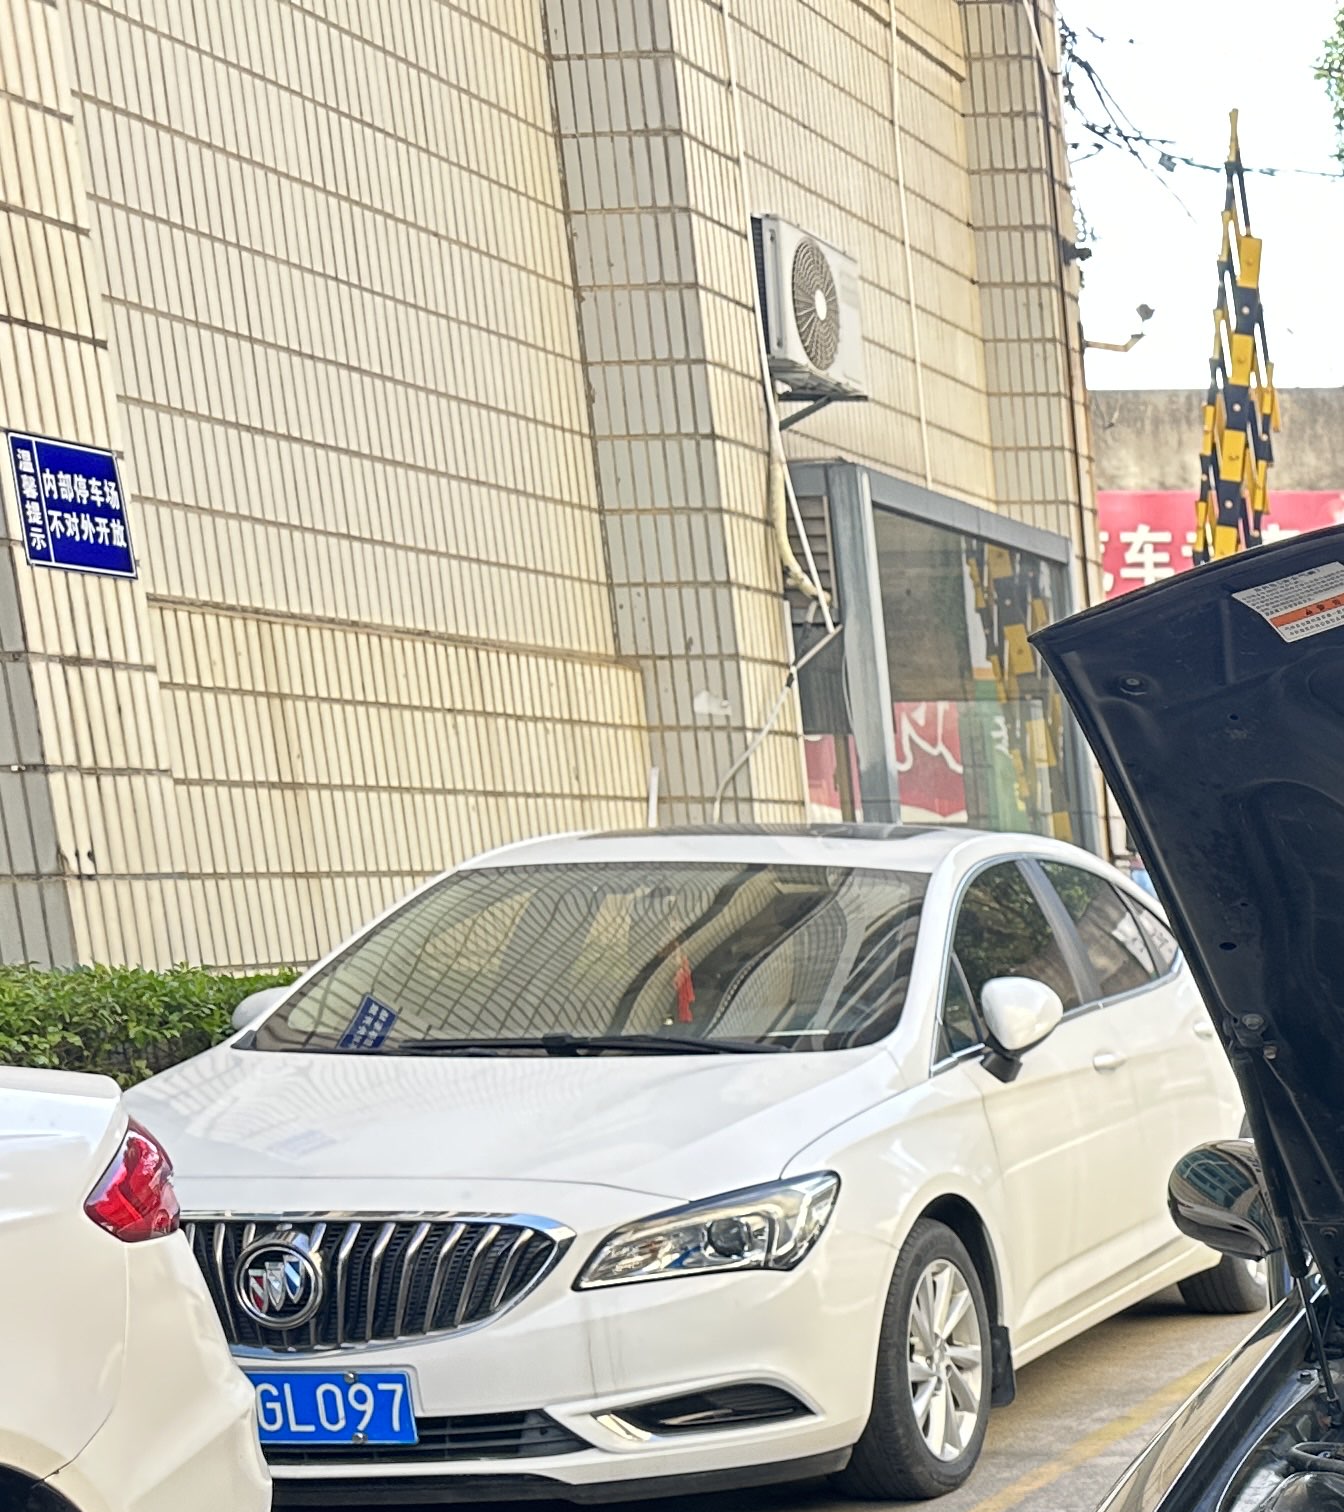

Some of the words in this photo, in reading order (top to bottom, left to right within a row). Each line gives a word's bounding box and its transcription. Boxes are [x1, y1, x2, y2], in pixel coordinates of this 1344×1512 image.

[16, 448, 47, 550] 温馨提示
[42, 468, 120, 510] 内部停车场
[47, 509, 127, 548] 不对外开放
[256, 1383, 405, 1433] GL097
